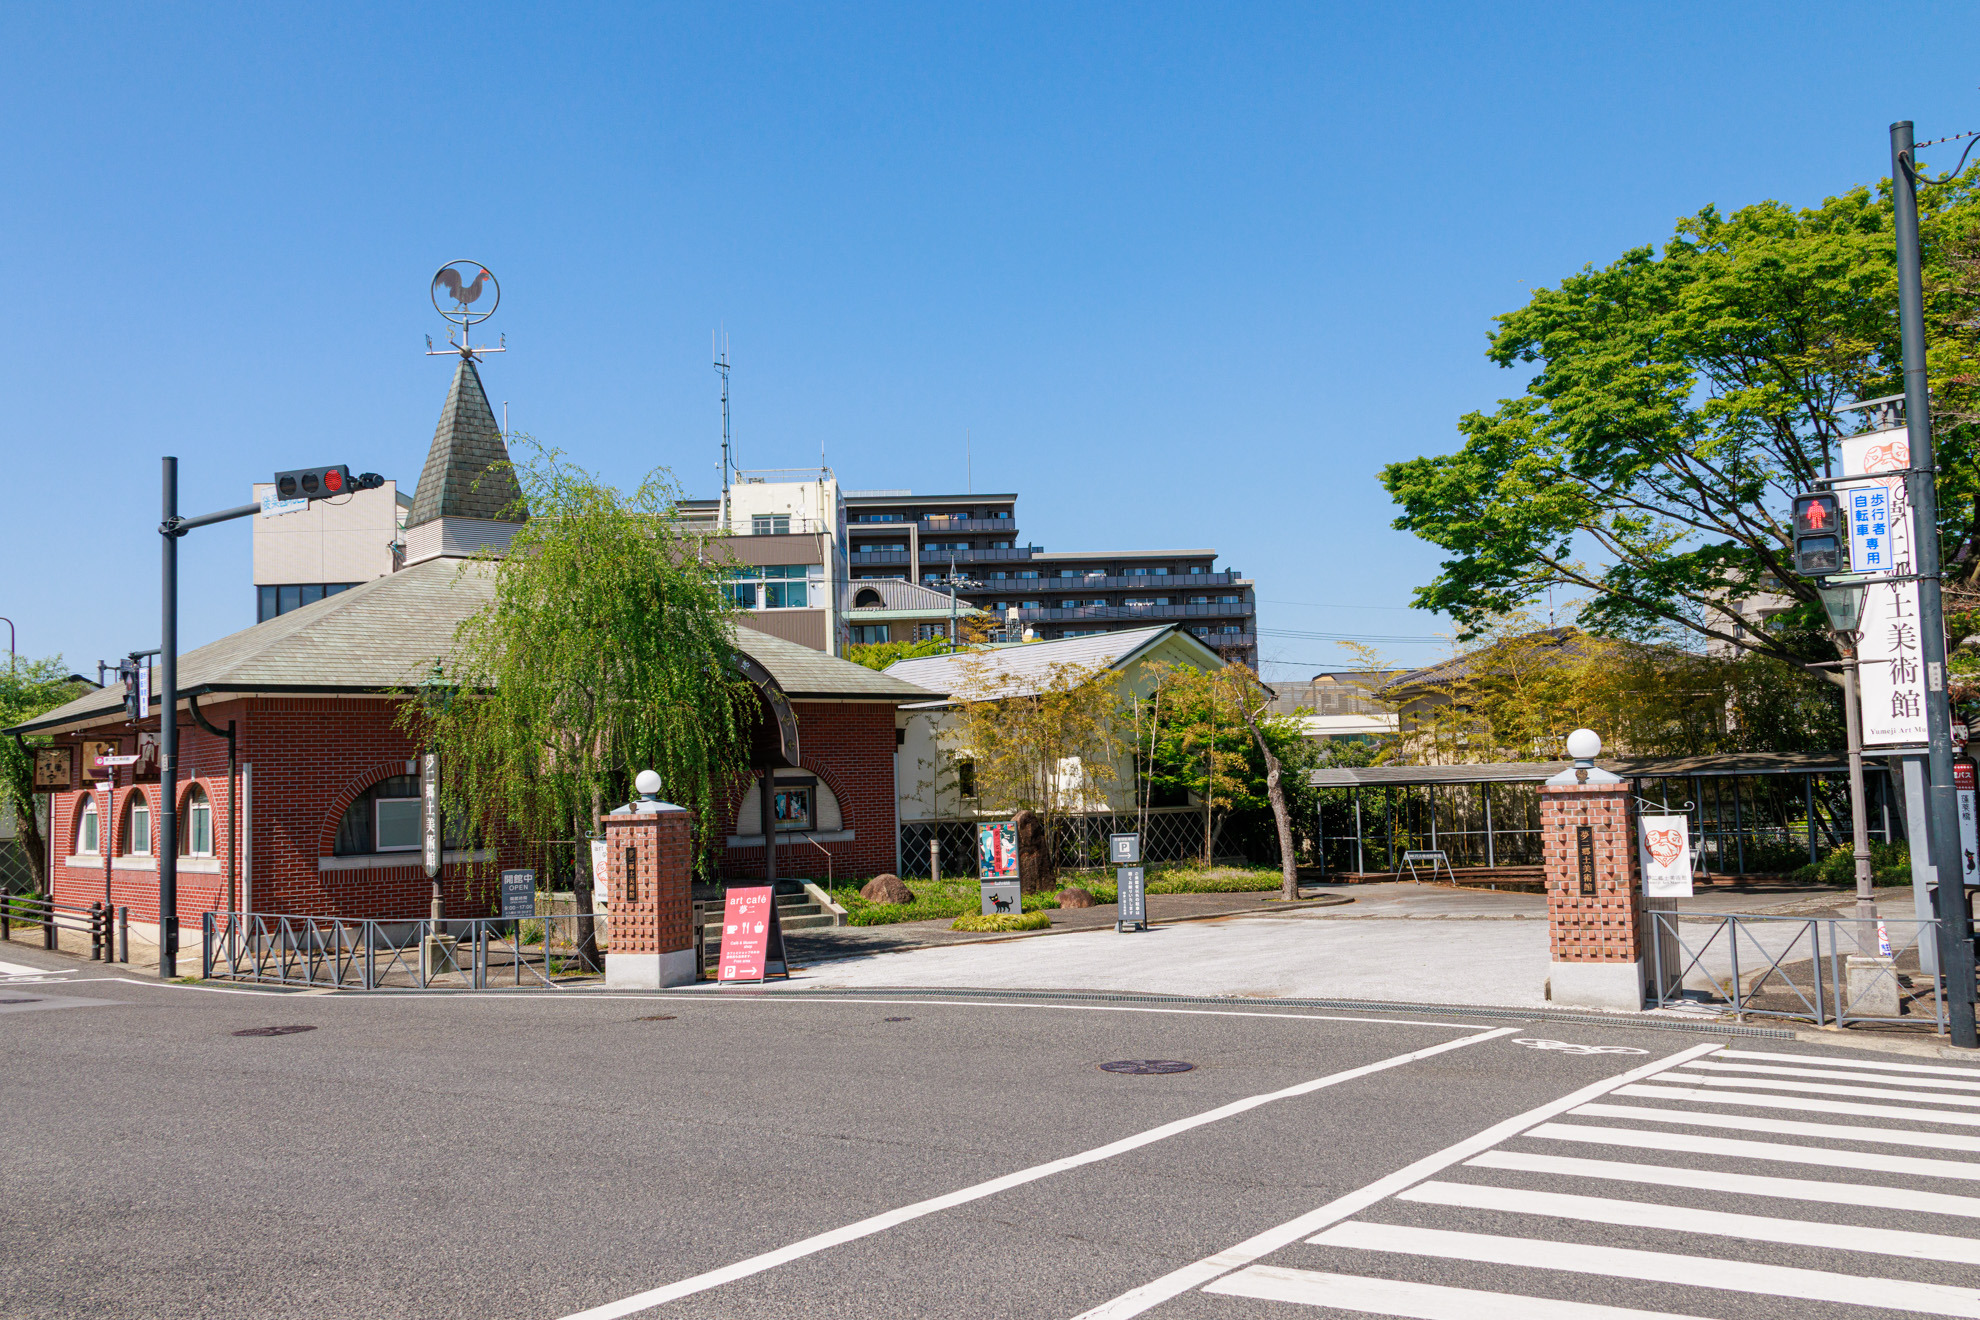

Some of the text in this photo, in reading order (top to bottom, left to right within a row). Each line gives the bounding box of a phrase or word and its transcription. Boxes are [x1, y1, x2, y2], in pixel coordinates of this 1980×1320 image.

[1855, 496, 1869, 536] 自転車
[1871, 493, 1885, 535] 歩行者
[1866, 538, 1880, 565] 専用
[425, 754, 436, 866] 夢二郷土美術館
[1580, 830, 1593, 892] 夢二郷土美術館
[504, 874, 533, 885] 開館中
[730, 894, 766, 905] art café
[739, 904, 755, 914] 夢二
